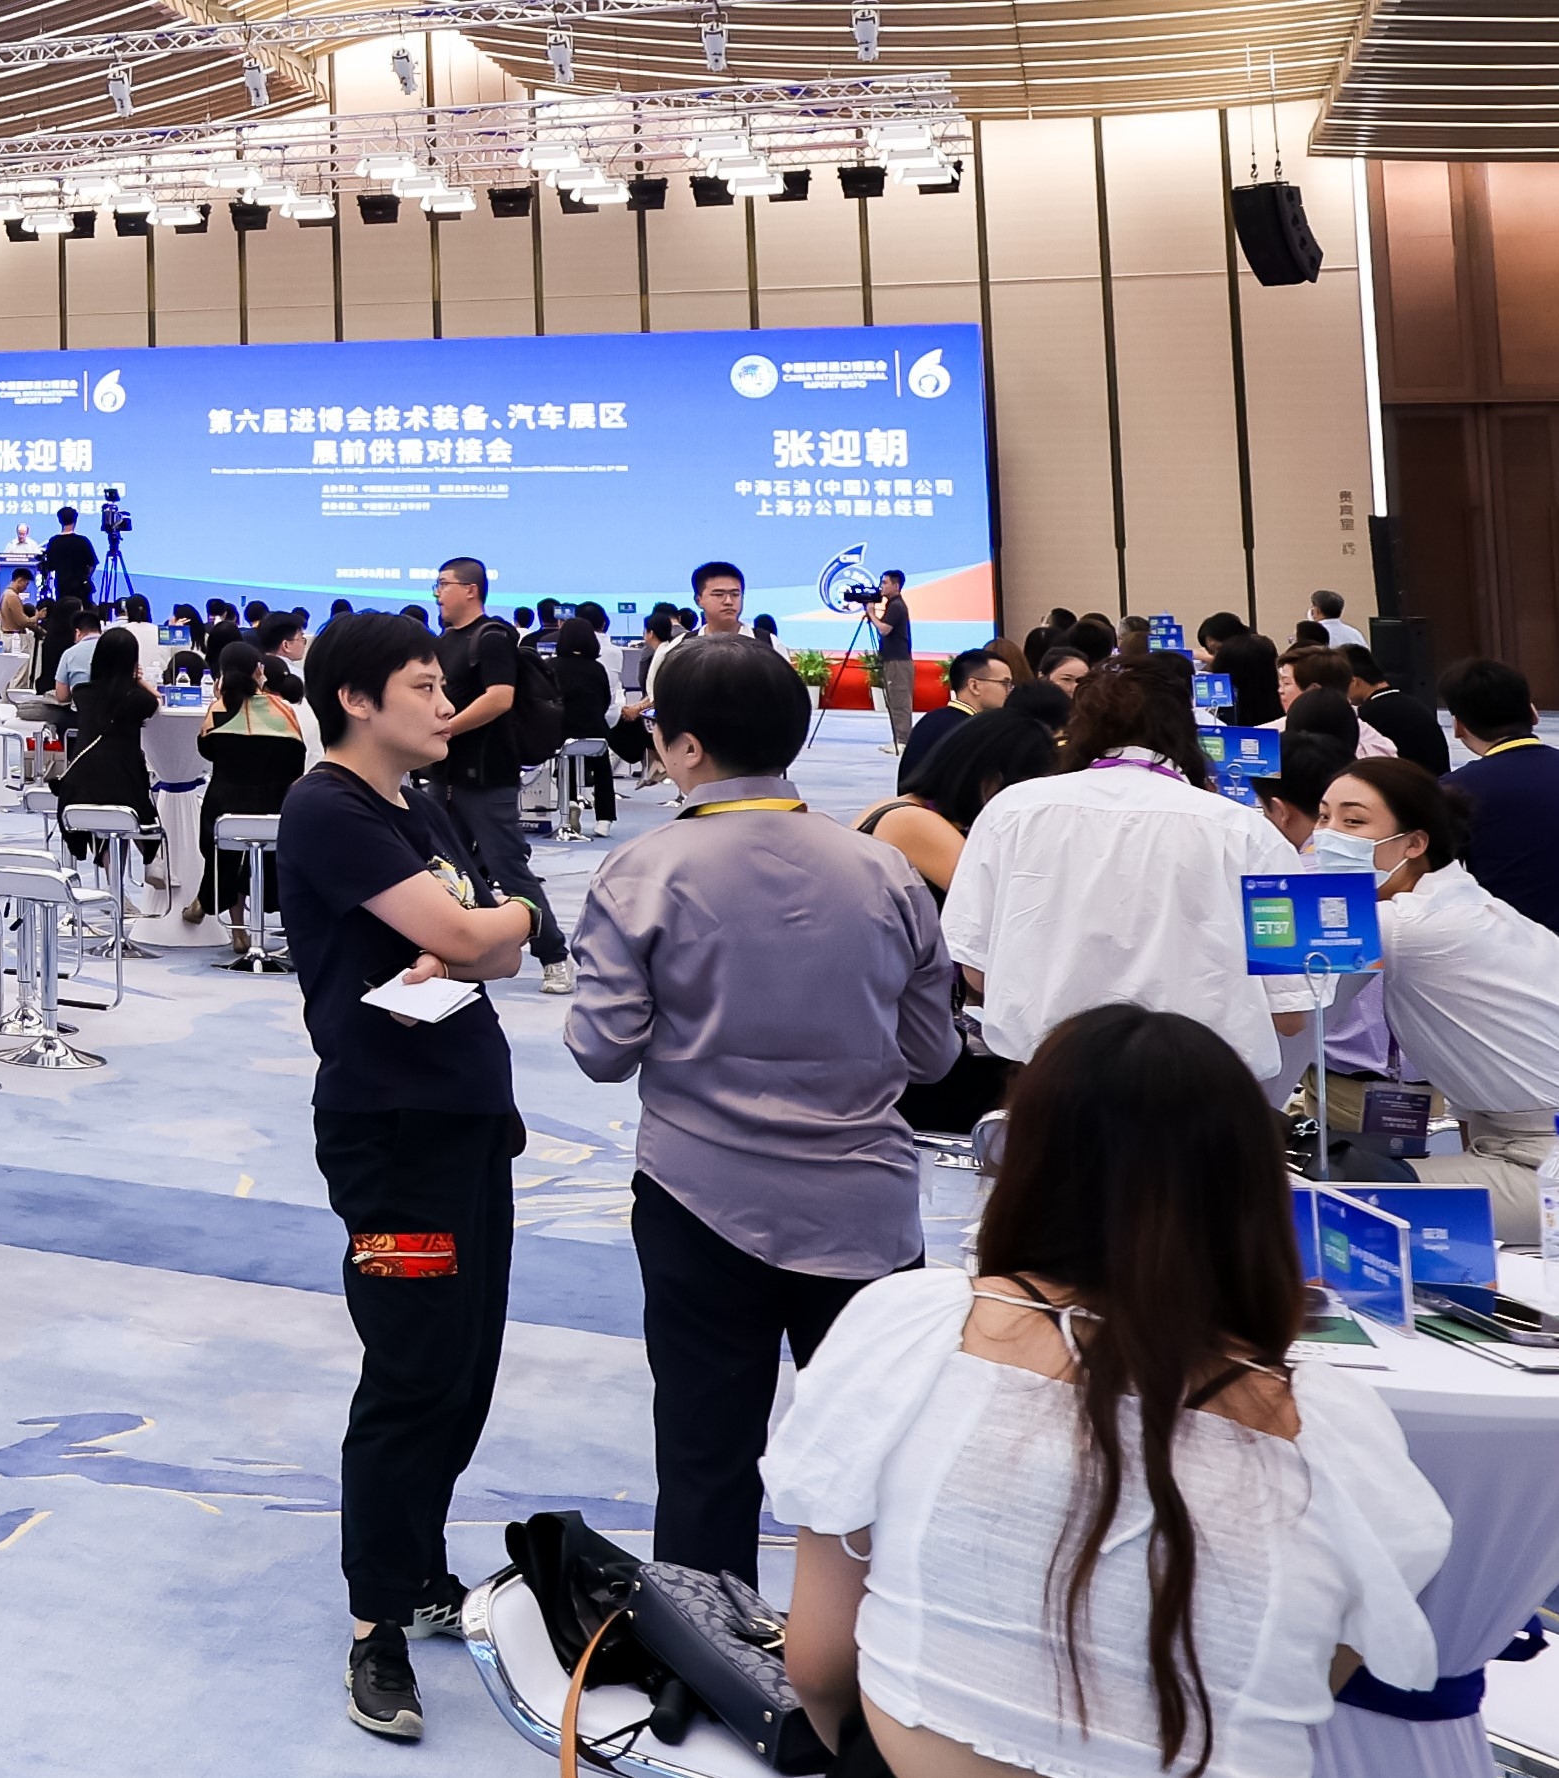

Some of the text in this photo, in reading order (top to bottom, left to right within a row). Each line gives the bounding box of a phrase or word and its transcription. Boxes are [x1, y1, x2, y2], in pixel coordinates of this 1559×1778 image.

[208, 402, 628, 434] 第六届进博会技术装备、汽车展区
[312, 437, 513, 465] 展前供需对接会
[773, 428, 908, 469] 张迎朝
[755, 499, 934, 517] 上海分公司副总经理
[1256, 921, 1290, 935] ET37
